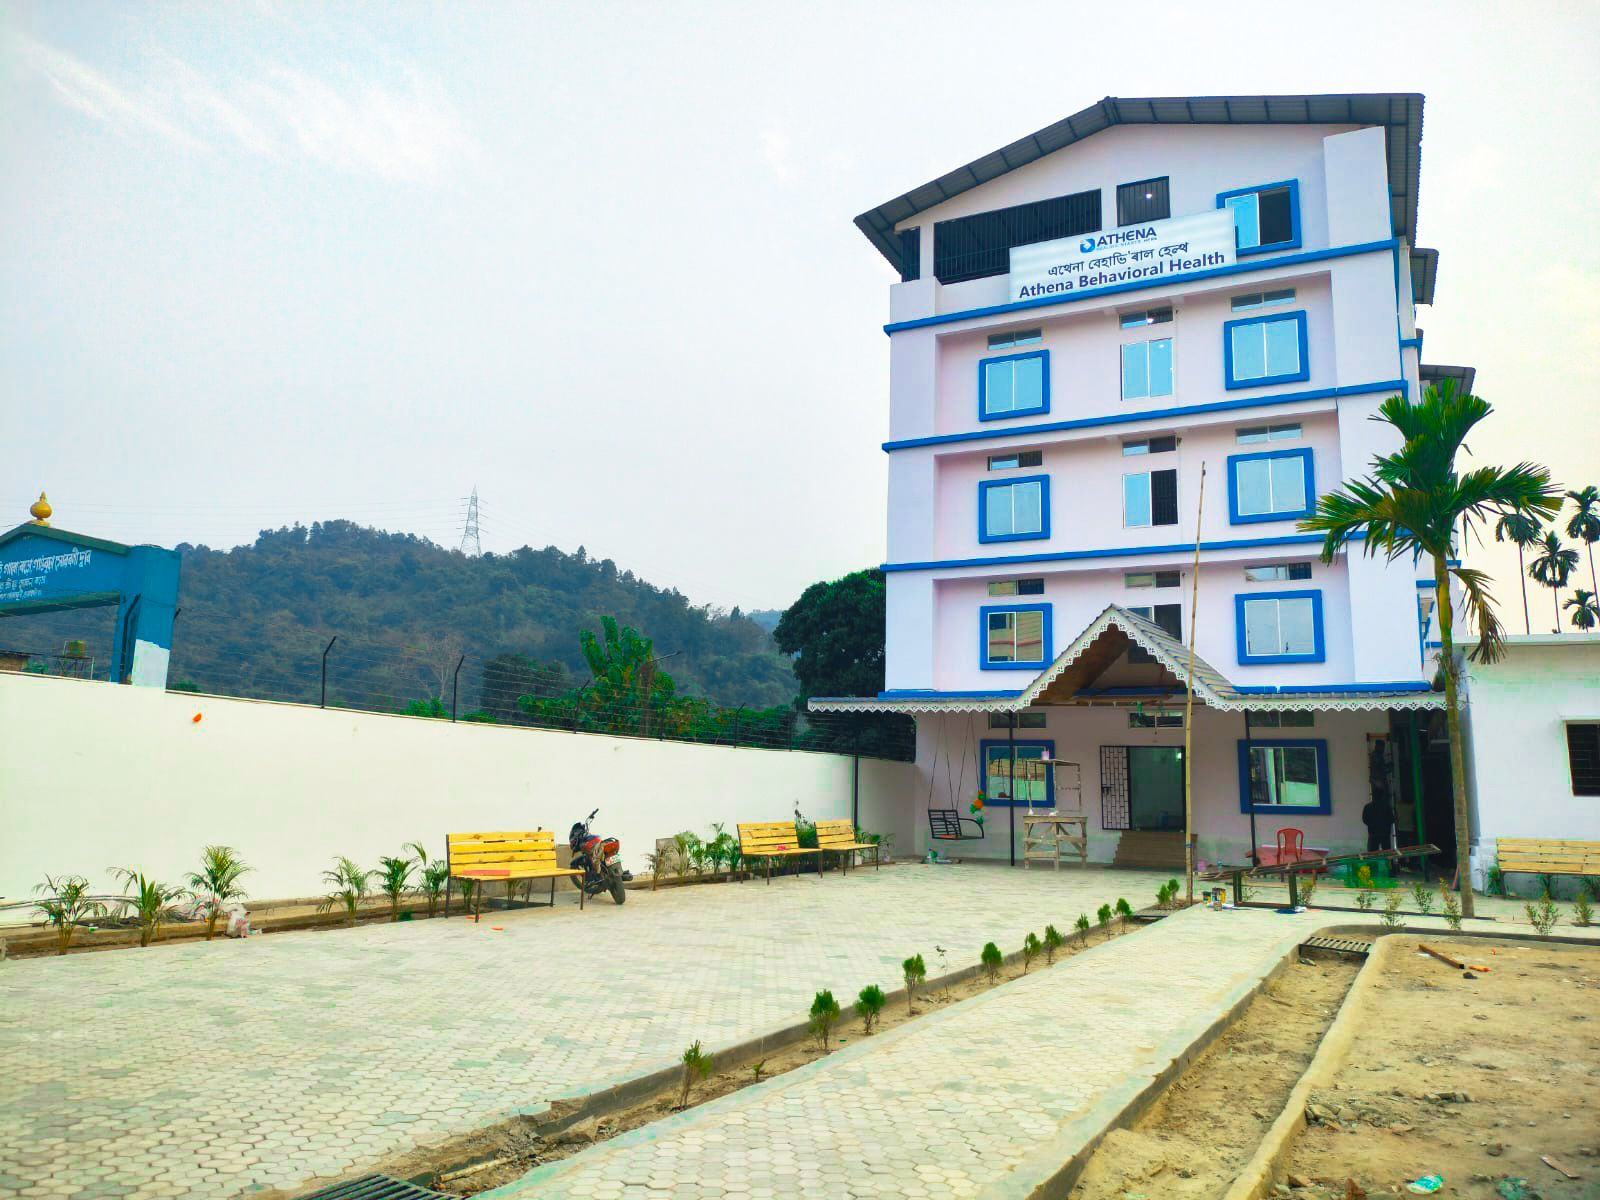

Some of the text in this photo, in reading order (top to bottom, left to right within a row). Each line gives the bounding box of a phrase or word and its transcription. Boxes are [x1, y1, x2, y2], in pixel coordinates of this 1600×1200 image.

[1097, 227, 1157, 247] ATHENA
[1019, 252, 1225, 298] Athena Behavioral Health
